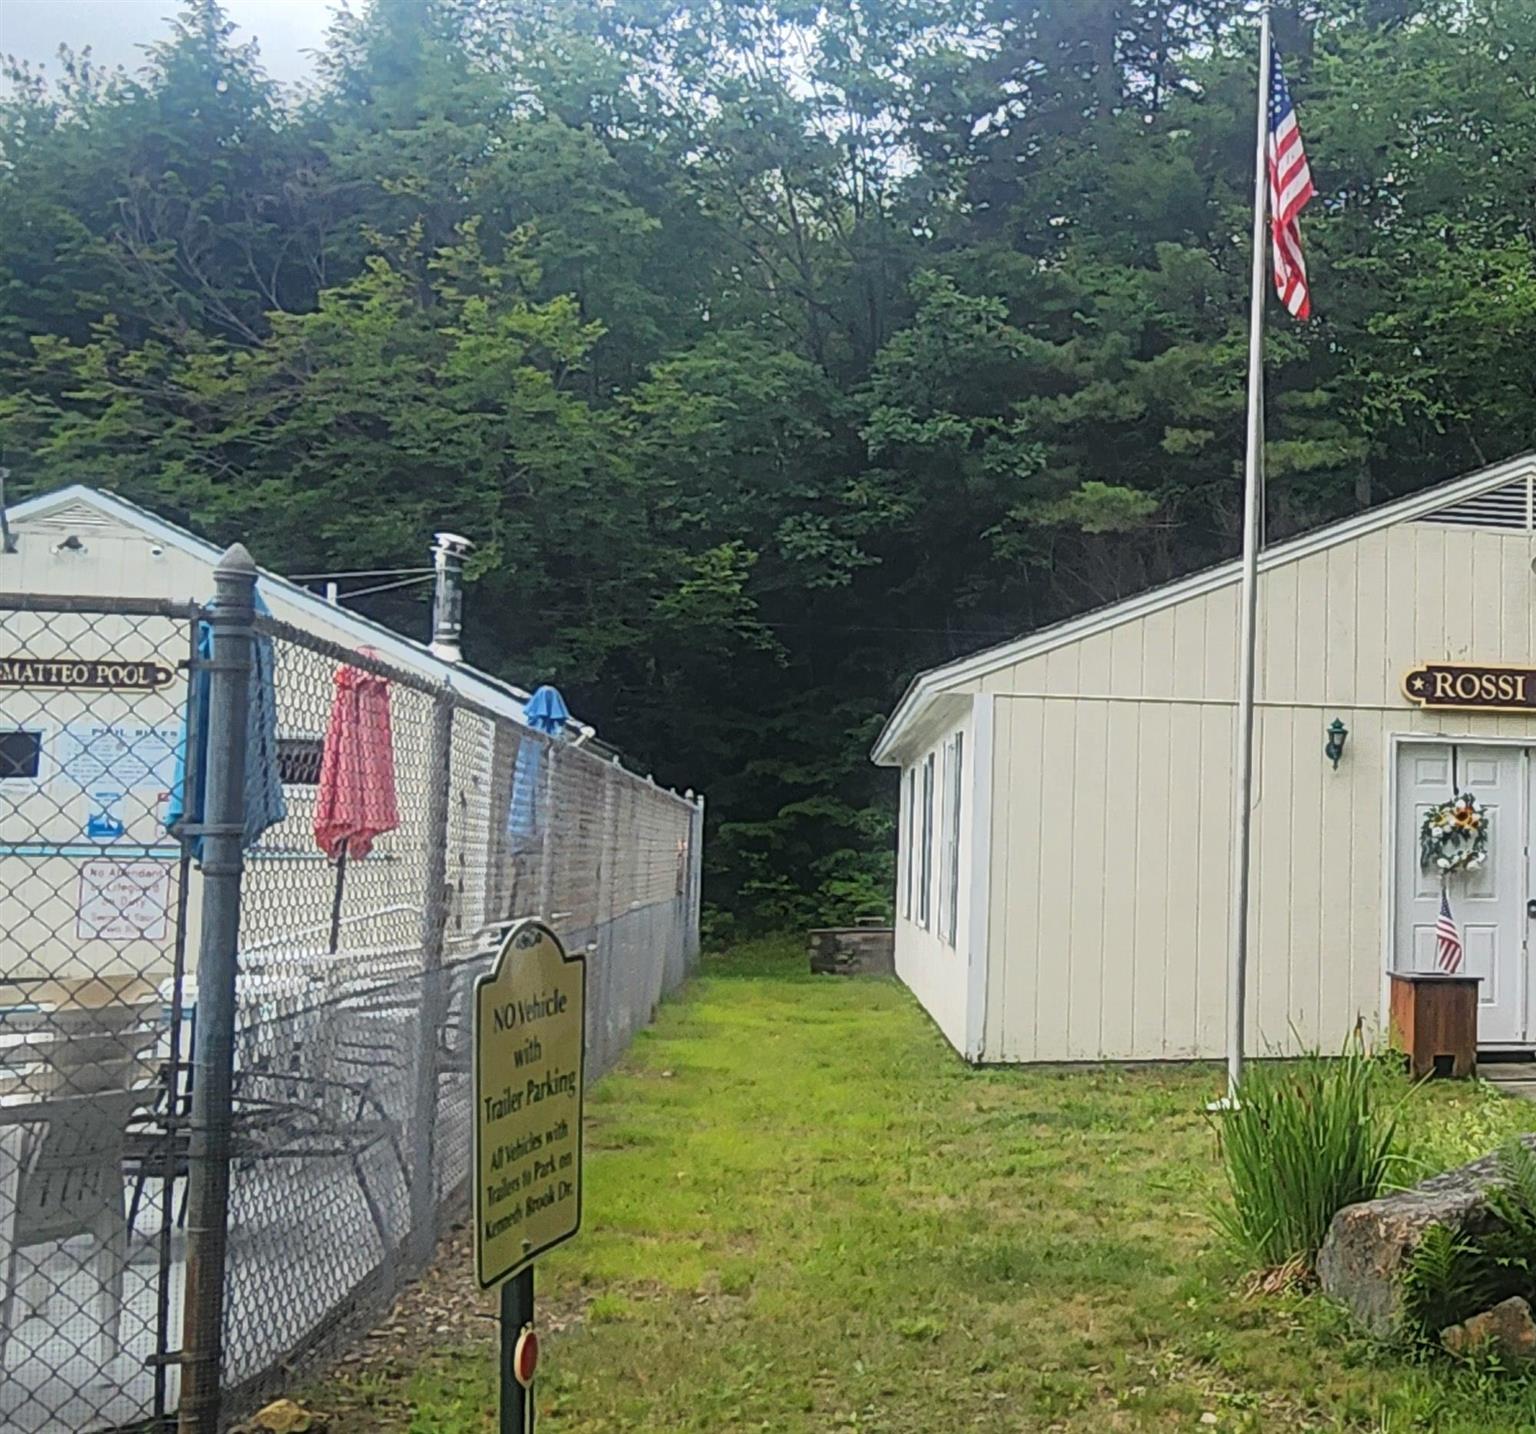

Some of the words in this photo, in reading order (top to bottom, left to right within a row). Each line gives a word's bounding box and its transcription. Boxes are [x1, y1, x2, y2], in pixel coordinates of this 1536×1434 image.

[0, 663, 89, 683] MATTEO
[96, 665, 150, 685] POOL
[1432, 671, 1527, 701] ROSSI
[91, 728, 125, 737] PL
[493, 1003, 516, 1034] NO
[518, 988, 568, 1025] Vehicle
[513, 1034, 542, 1068] with
[484, 1086, 524, 1123] Trailer
[526, 1067, 576, 1106] Parking
[490, 1144, 504, 1173] All
[505, 1131, 543, 1163] Vehicles
[545, 1118, 569, 1145] with
[486, 1177, 520, 1207] Trailers
[521, 1169, 532, 1188] to
[533, 1153, 556, 1181] Park
[559, 1151, 573, 1169] on
[525, 1183, 555, 1218] Brook
[558, 1180, 574, 1202] Dr.
